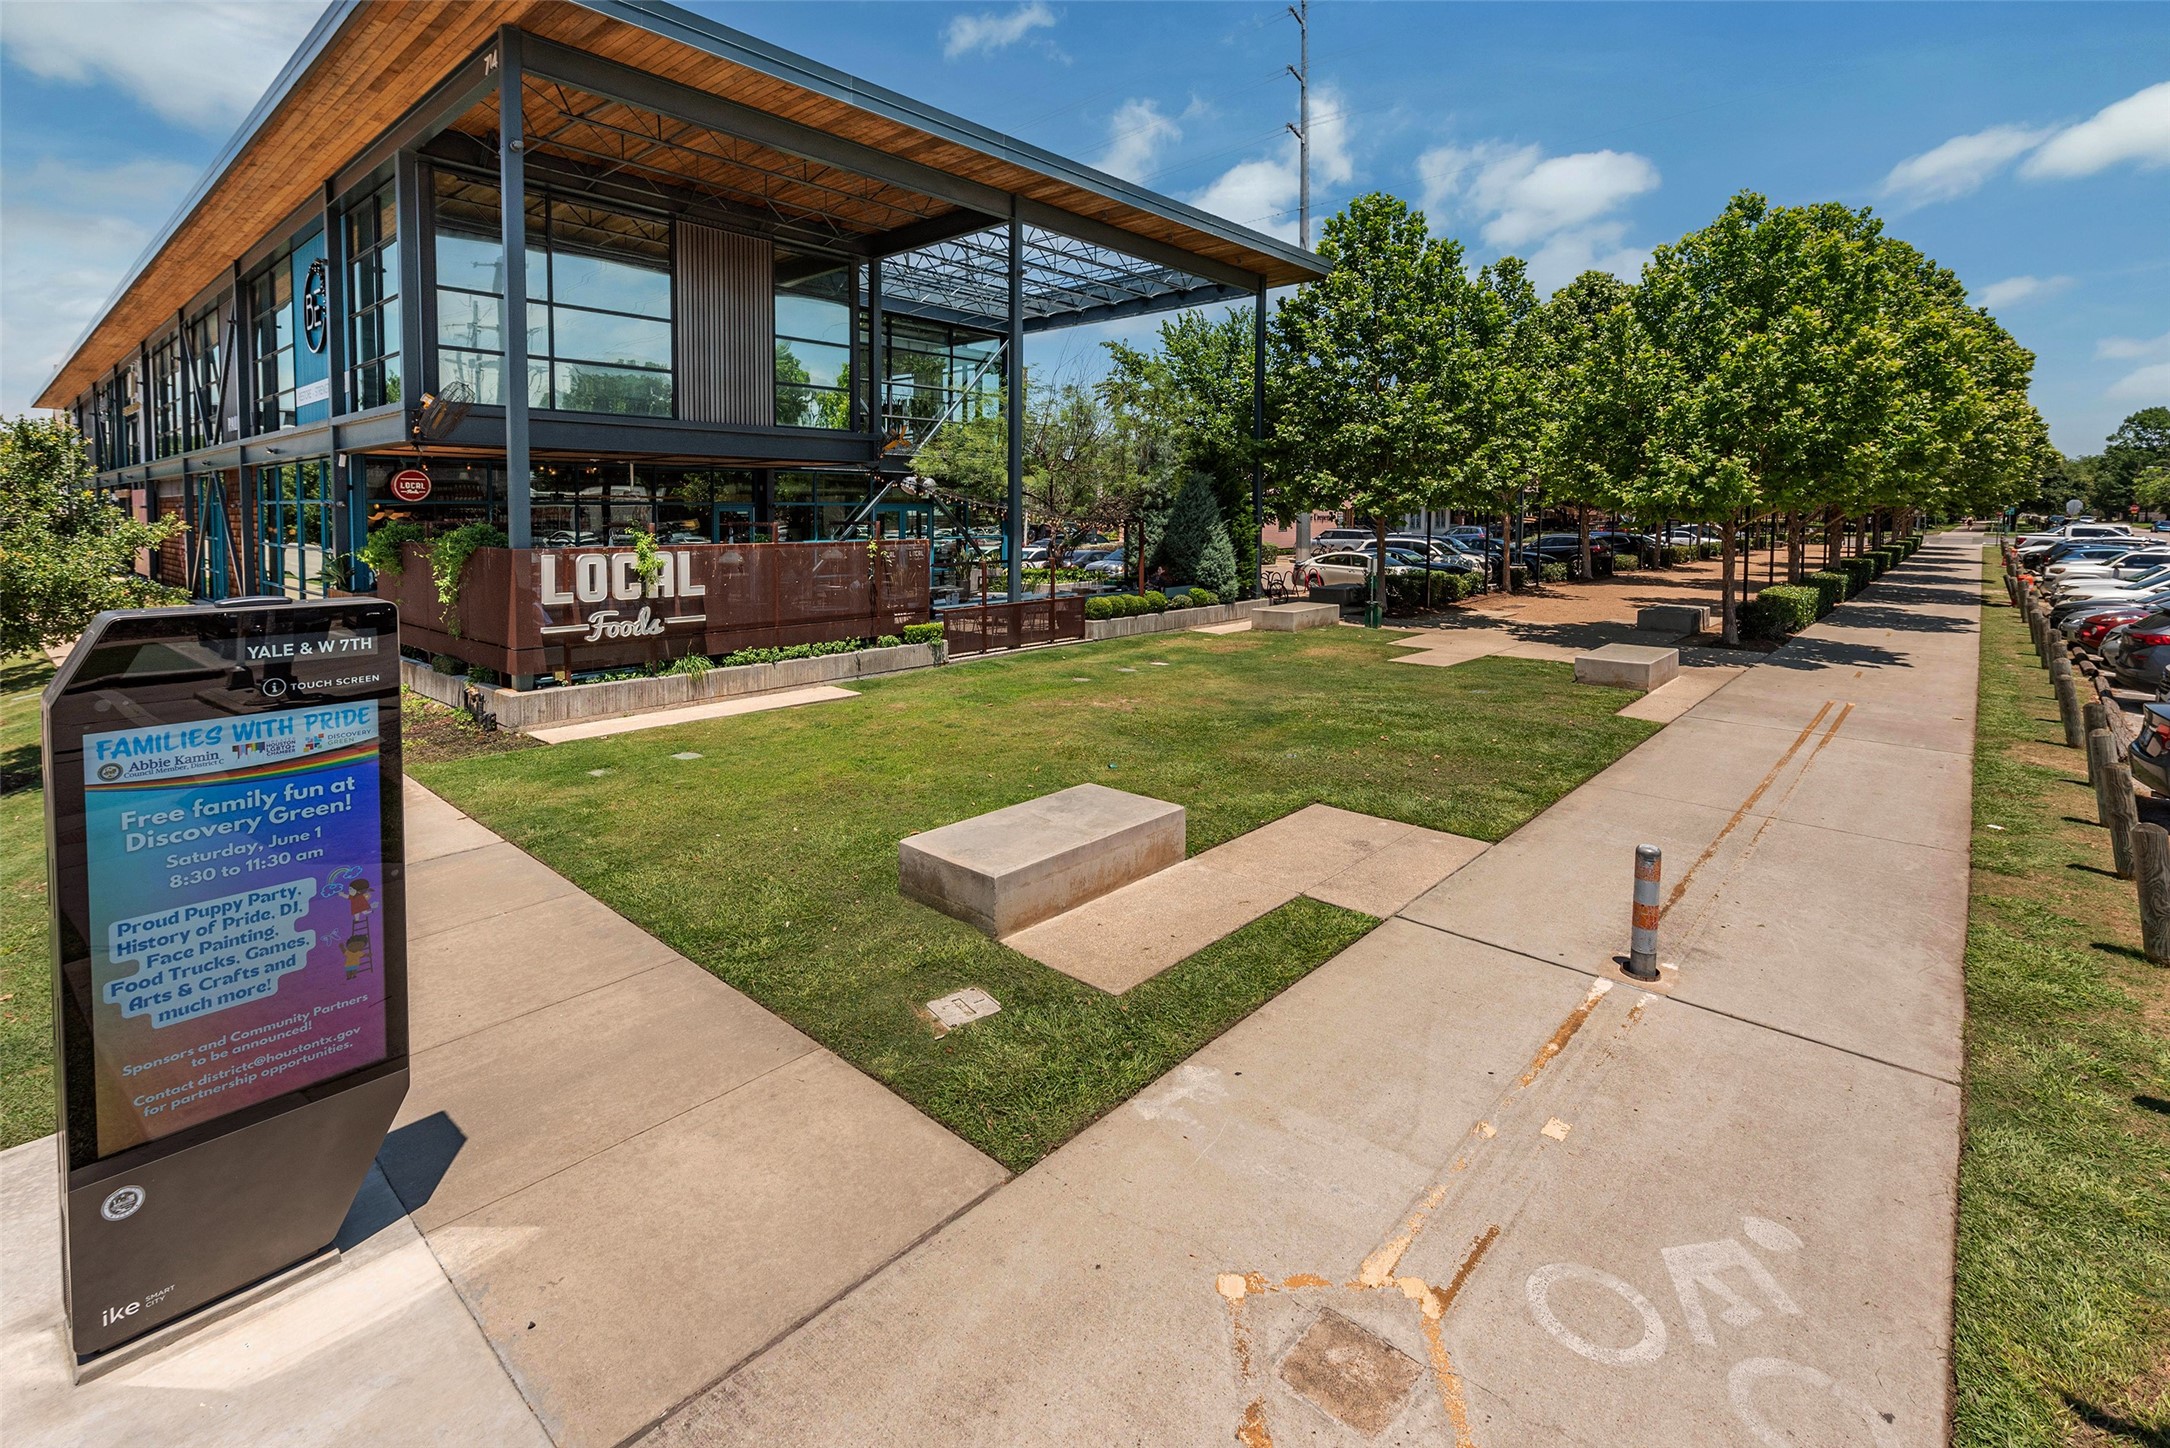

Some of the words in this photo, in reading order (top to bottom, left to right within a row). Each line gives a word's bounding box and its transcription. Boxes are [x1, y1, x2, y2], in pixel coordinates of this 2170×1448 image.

[400, 481, 425, 489] LOCAL
[540, 551, 706, 604] LOCAL
[584, 606, 665, 642] Foods
[247, 643, 294, 659] YALE
[300, 642, 313, 655] &
[318, 640, 335, 653] W
[339, 637, 372, 652] 7TH
[290, 679, 332, 691] TOUCH
[336, 674, 380, 686] SCREEN
[96, 725, 222, 760] FAMILIES
[232, 716, 294, 742] WITH
[304, 707, 370, 732] PRIDE
[266, 740, 296, 748] HOUSTON
[266, 744, 295, 753] LGBTQ+
[327, 729, 372, 740] DISCOVERY
[327, 737, 355, 746] GREEN
[123, 769, 154, 779] Council
[155, 764, 189, 774] Member,
[191, 760, 218, 769] District
[129, 758, 171, 772] Abbie
[175, 751, 219, 765] Kamin
[121, 808, 185, 831] Free
[192, 789, 277, 818] family
[283, 783, 324, 801] fun
[330, 776, 355, 792] at
[126, 816, 261, 852] Discovery
[269, 794, 352, 824] Green!
[166, 842, 264, 869] Saturday,
[268, 832, 310, 848] June
[315, 826, 322, 838] 1
[169, 868, 216, 888] 8:30
[221, 865, 241, 878] to
[246, 852, 291, 872] 11:30
[295, 848, 324, 861] am
[117, 910, 179, 937] Proud
[185, 899, 242, 922] Puppy
[116, 929, 190, 957] History
[196, 919, 217, 937] of
[147, 947, 194, 968] Face
[110, 973, 163, 997] Food
[128, 990, 172, 1012] Arts
[178, 983, 192, 997] &
[198, 966, 260, 991] Crafts
[264, 953, 296, 974] and
[158, 998, 212, 1023] much
[217, 979, 272, 1005] more!
[122, 1049, 195, 1077] Sponsors
[198, 1035, 227, 1052] and
[230, 1012, 310, 1042] Community
[313, 993, 369, 1016] Partners
[191, 1055, 207, 1067] to
[210, 1048, 228, 1061] be
[232, 1021, 312, 1053] announced!
[133, 1080, 195, 1107] Contact
[197, 1026, 361, 1086] districtc@houstontx.gov
[143, 1102, 167, 1118] for
[171, 1072, 257, 1111] partnership
[261, 1042, 353, 1081] opportunities.
[102, 1301, 141, 1327] ike
[145, 1284, 175, 1301] SMART
[145, 1295, 166, 1308] CITY
